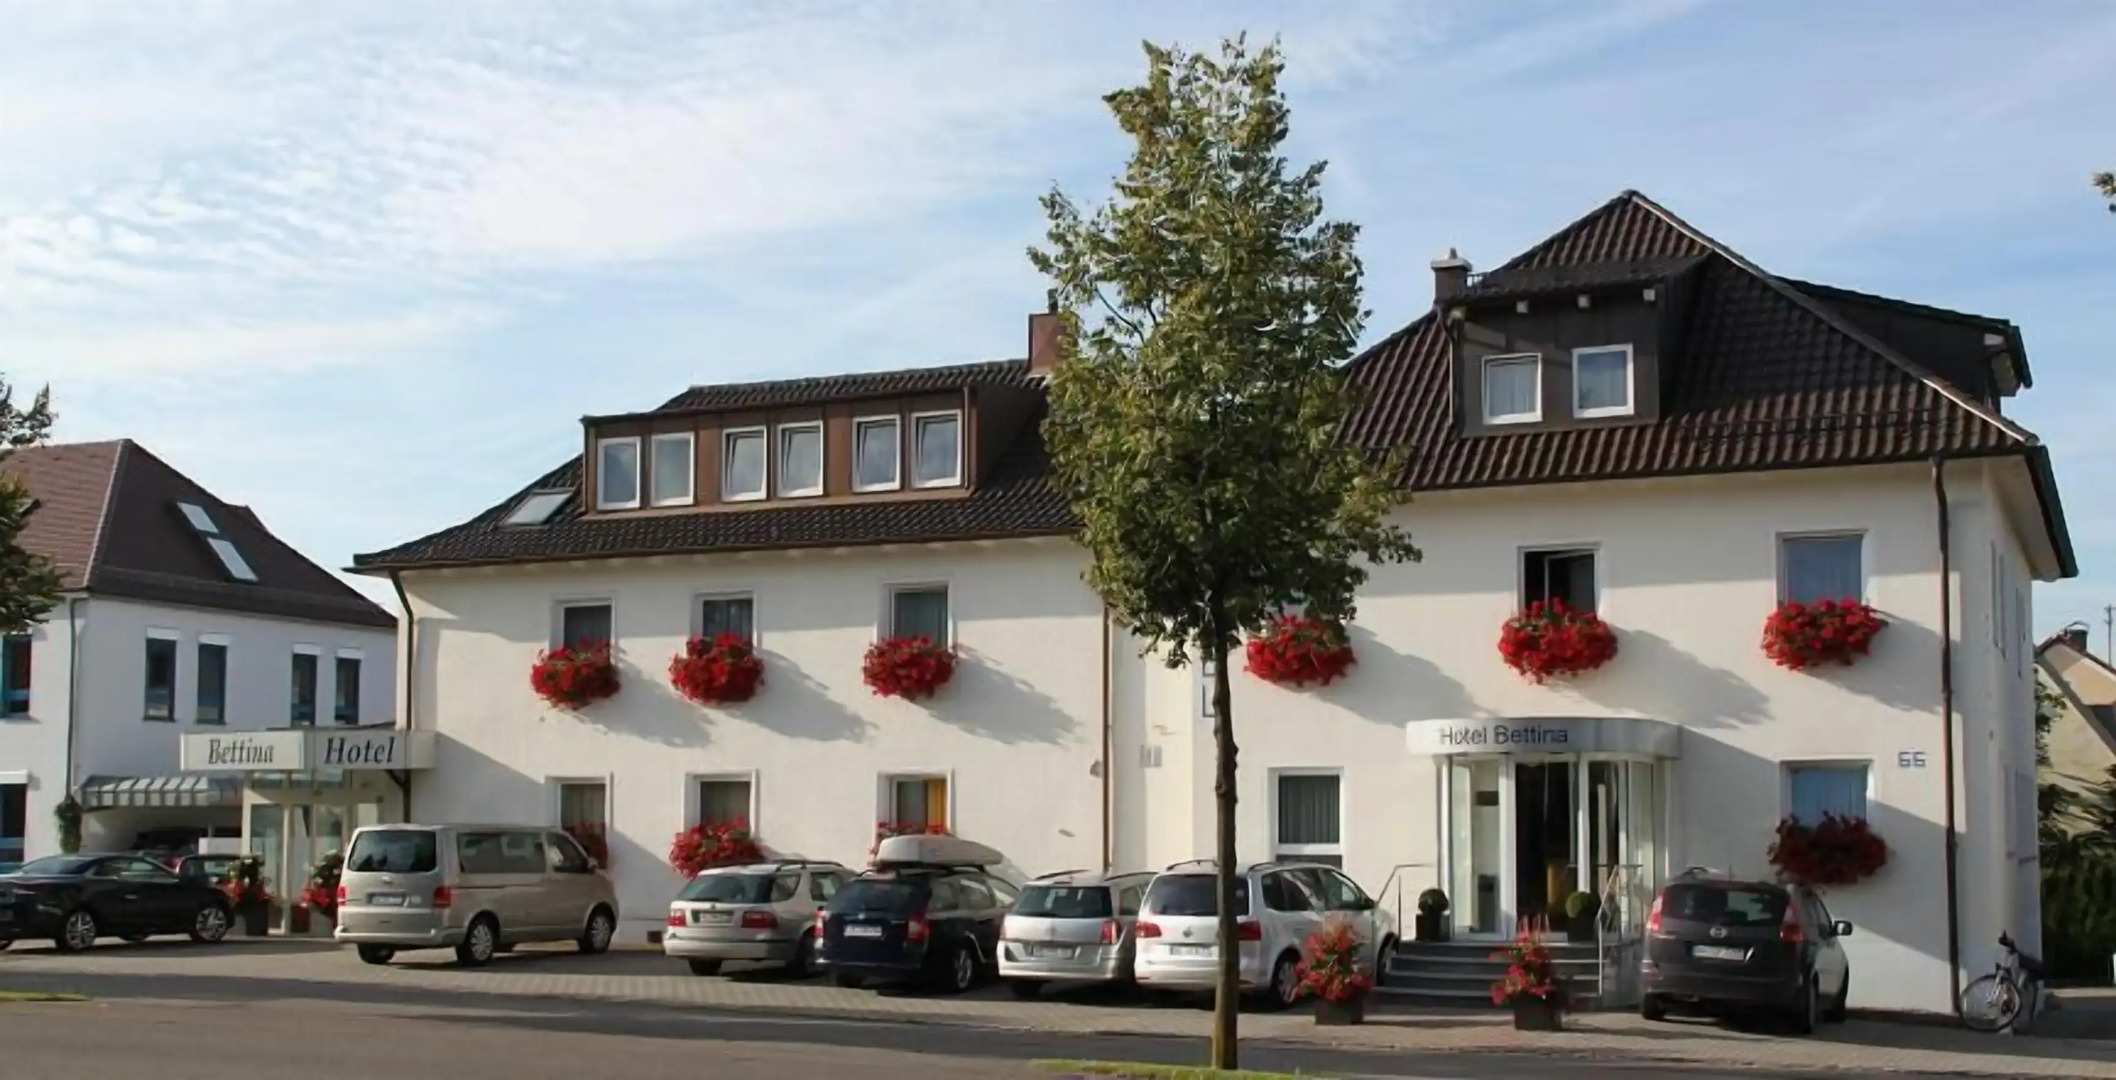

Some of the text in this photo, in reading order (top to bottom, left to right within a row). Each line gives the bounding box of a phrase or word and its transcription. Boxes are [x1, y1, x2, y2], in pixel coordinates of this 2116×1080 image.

[1440, 724, 1568, 745] Hotel Bettina
[208, 738, 274, 764] Bettina
[324, 736, 395, 764] Hotel
